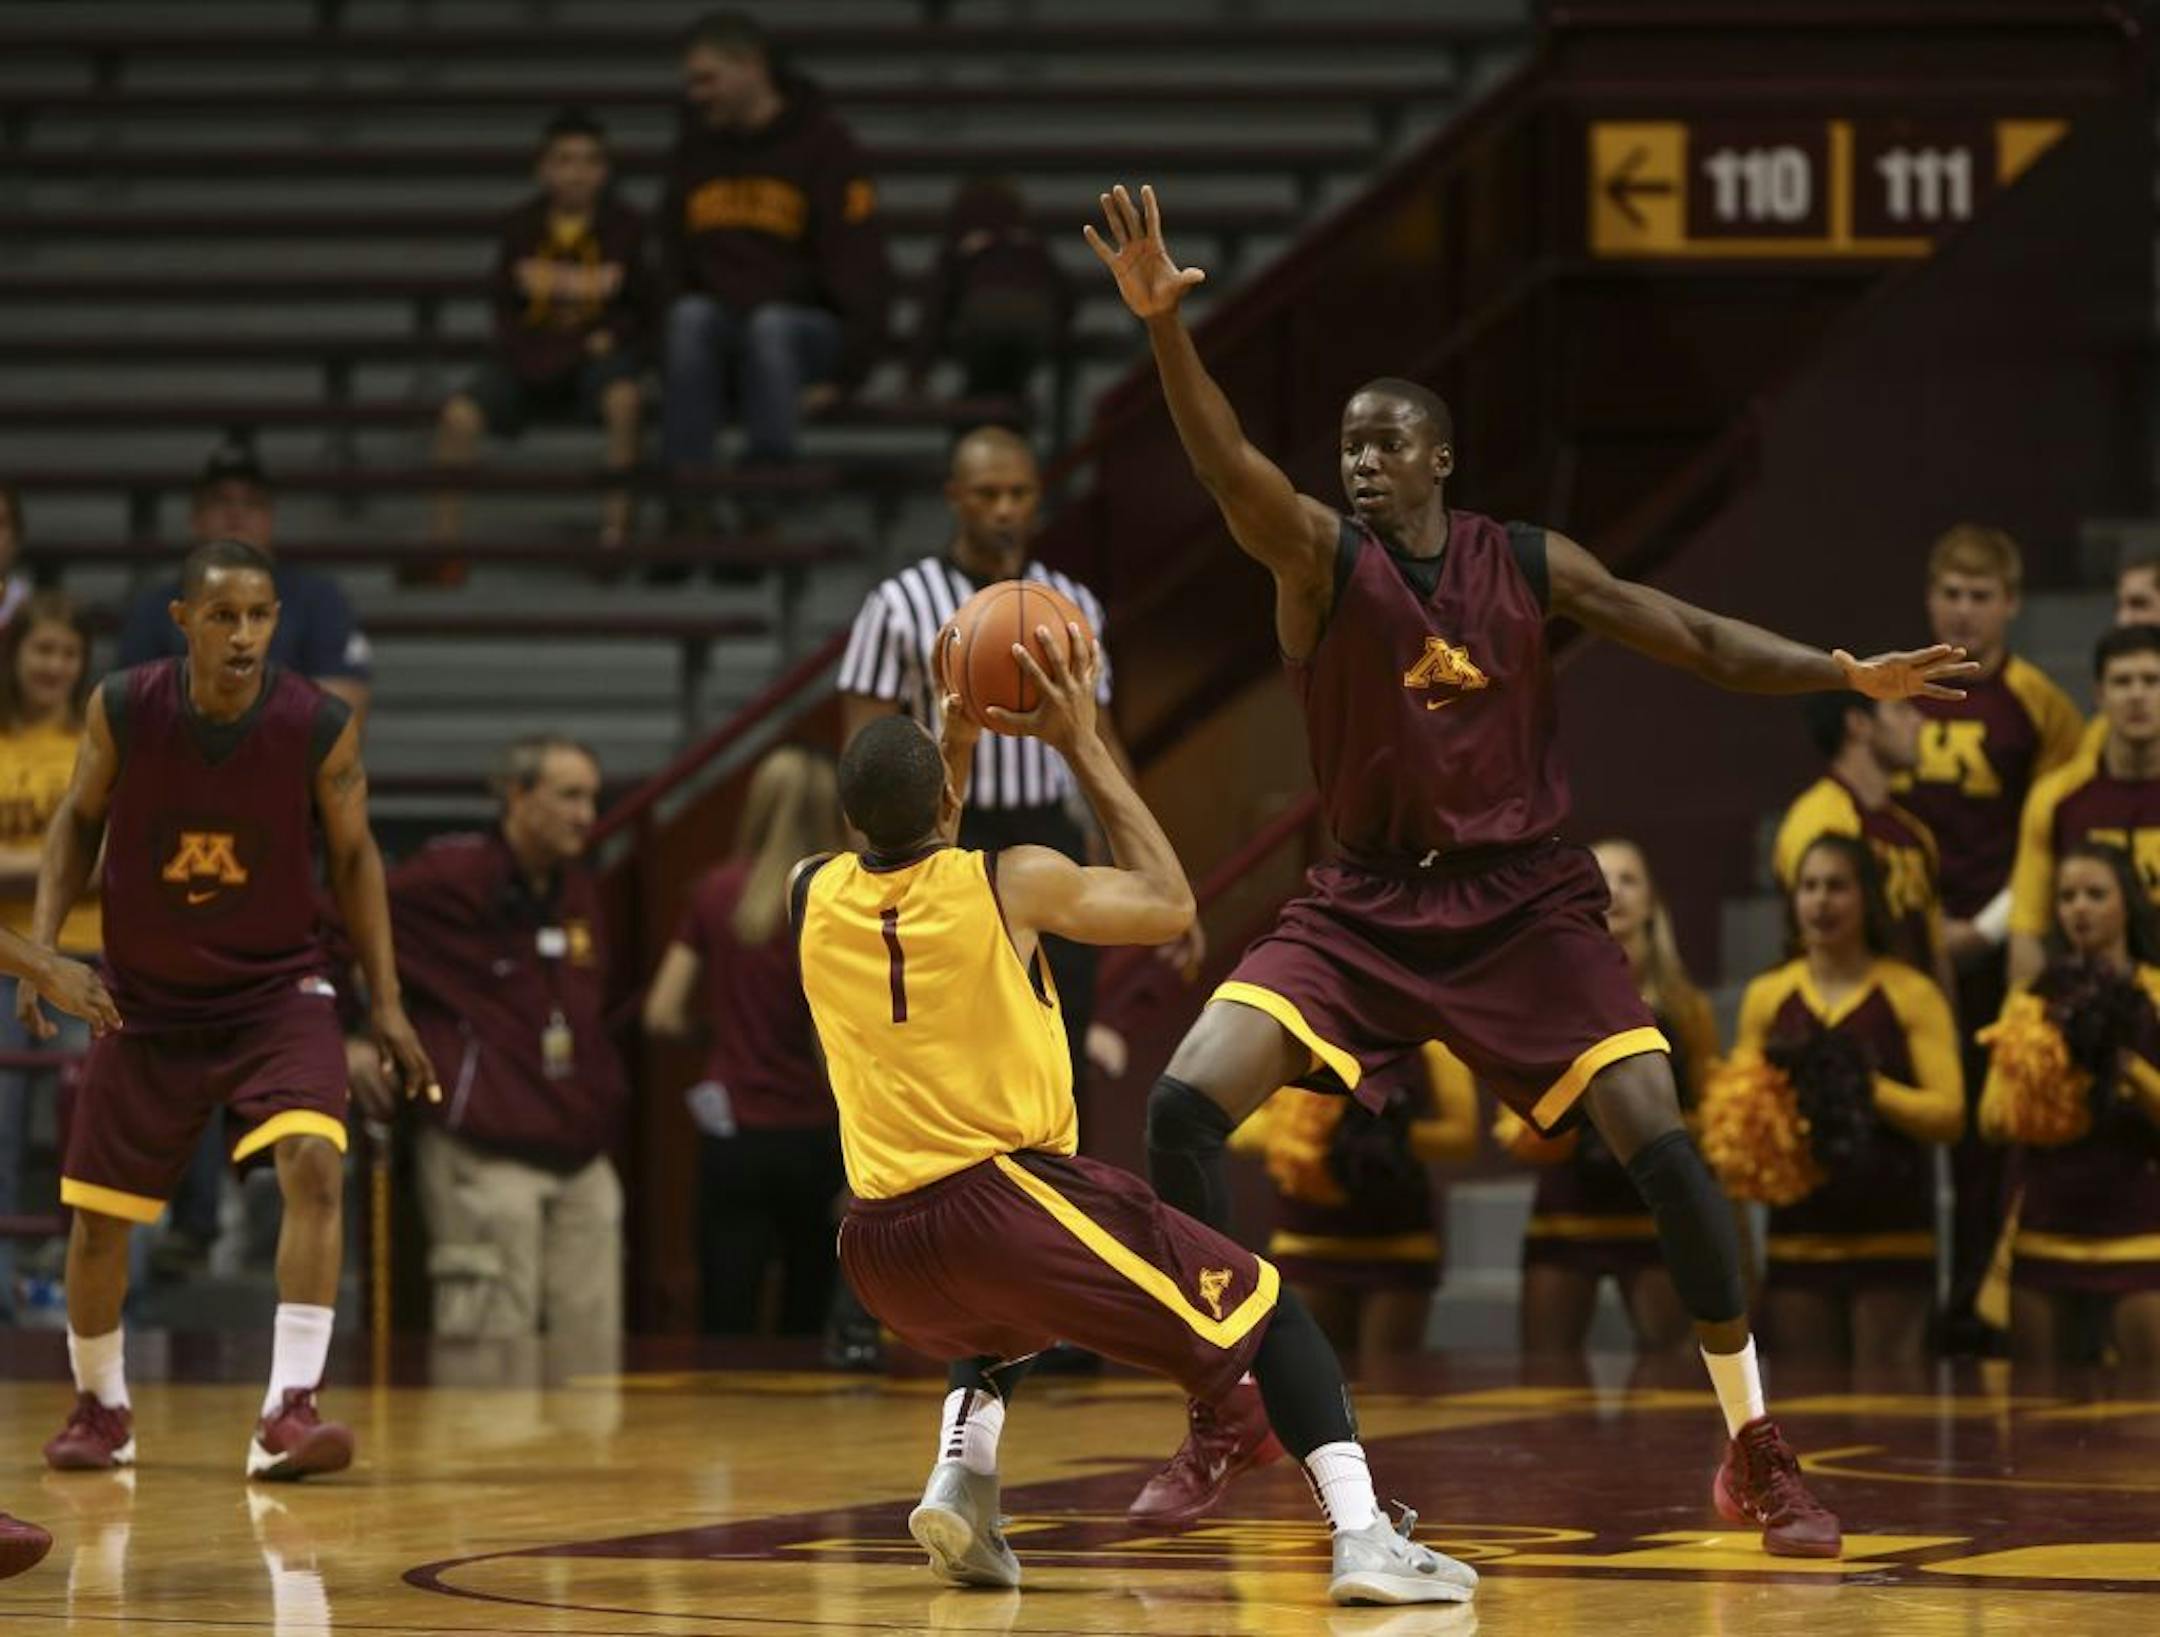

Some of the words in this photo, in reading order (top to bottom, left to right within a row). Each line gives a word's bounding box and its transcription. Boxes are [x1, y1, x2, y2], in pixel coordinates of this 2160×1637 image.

[1704, 145, 1812, 222] 110
[1877, 145, 1972, 221] 111
[162, 832, 249, 884] M
[880, 907, 907, 1023] 1
